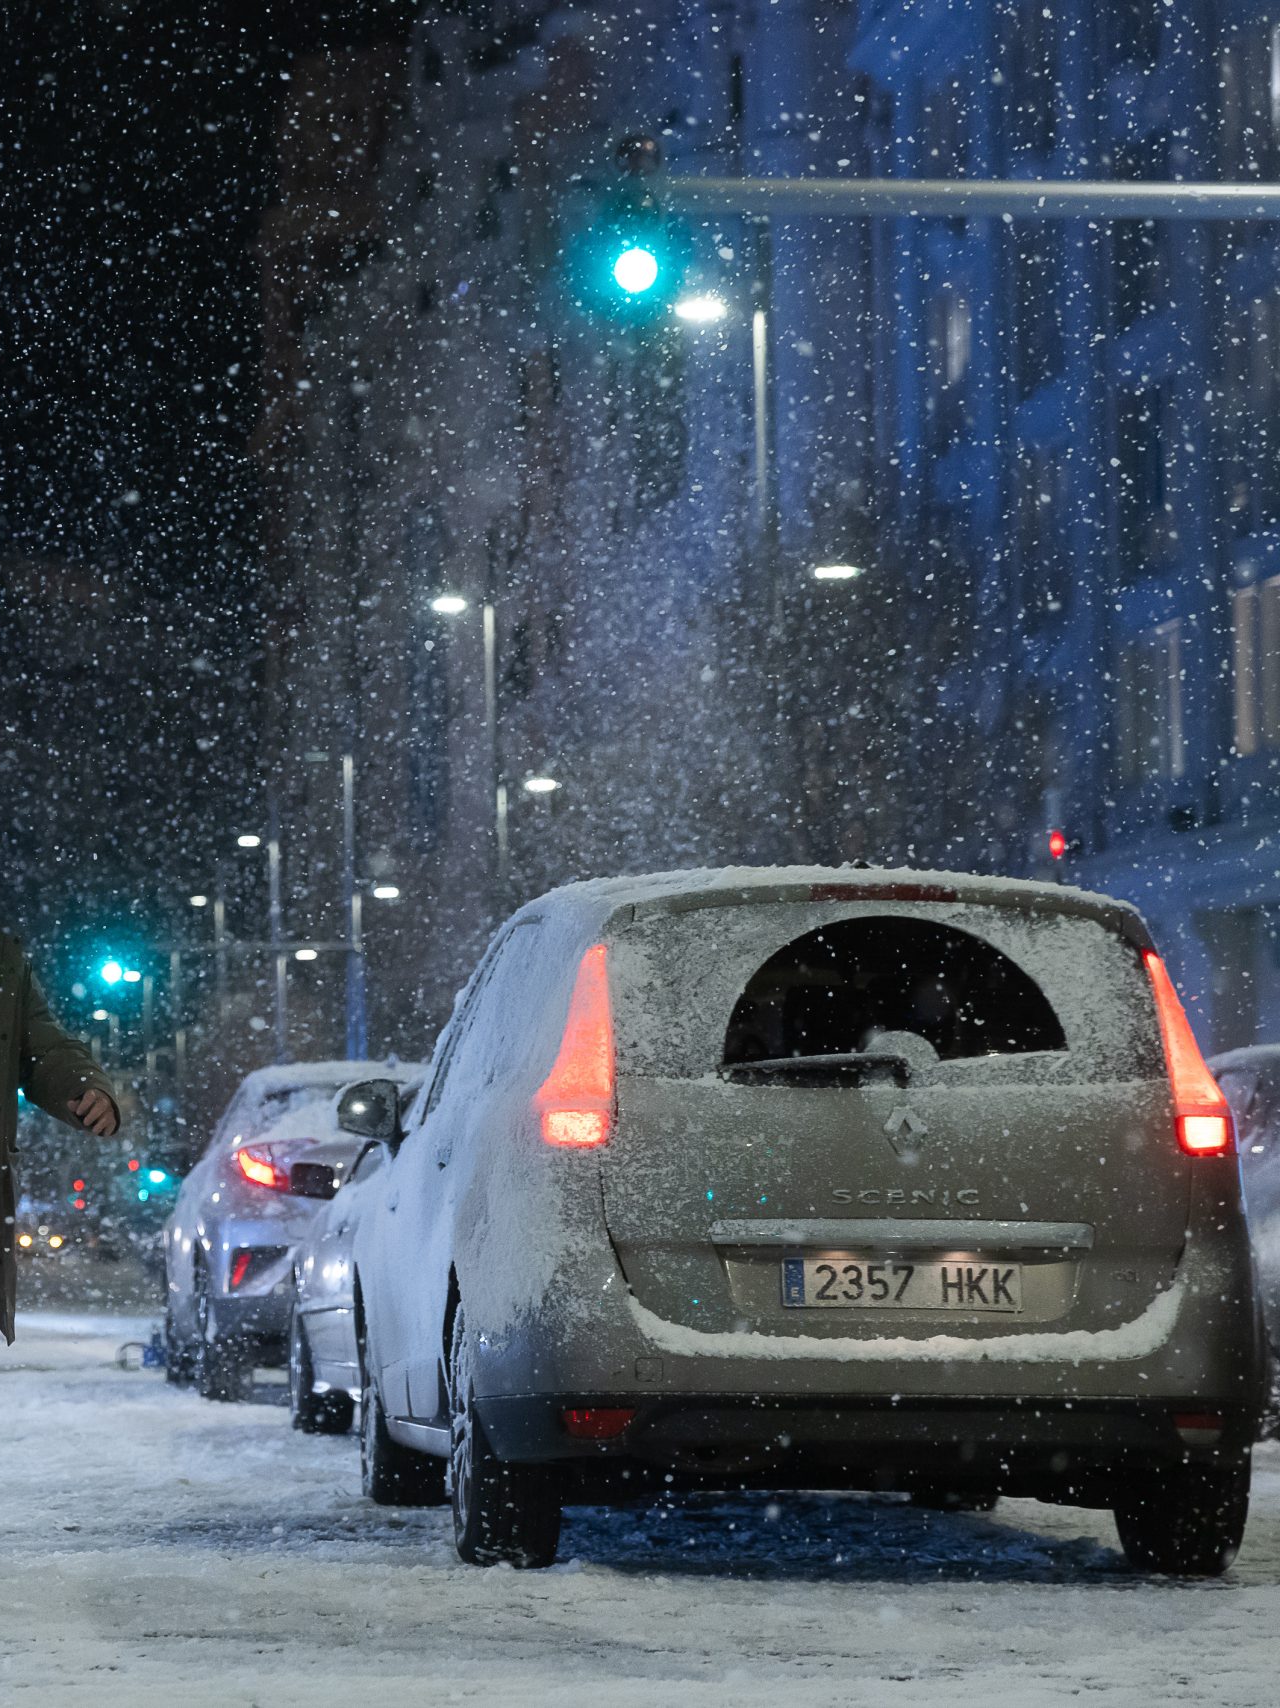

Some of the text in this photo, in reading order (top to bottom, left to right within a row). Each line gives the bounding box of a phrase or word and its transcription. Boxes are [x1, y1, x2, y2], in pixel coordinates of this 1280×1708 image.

[831, 1188, 980, 1205] SCENIC
[791, 1264, 1017, 1305] E 2357 HKK
